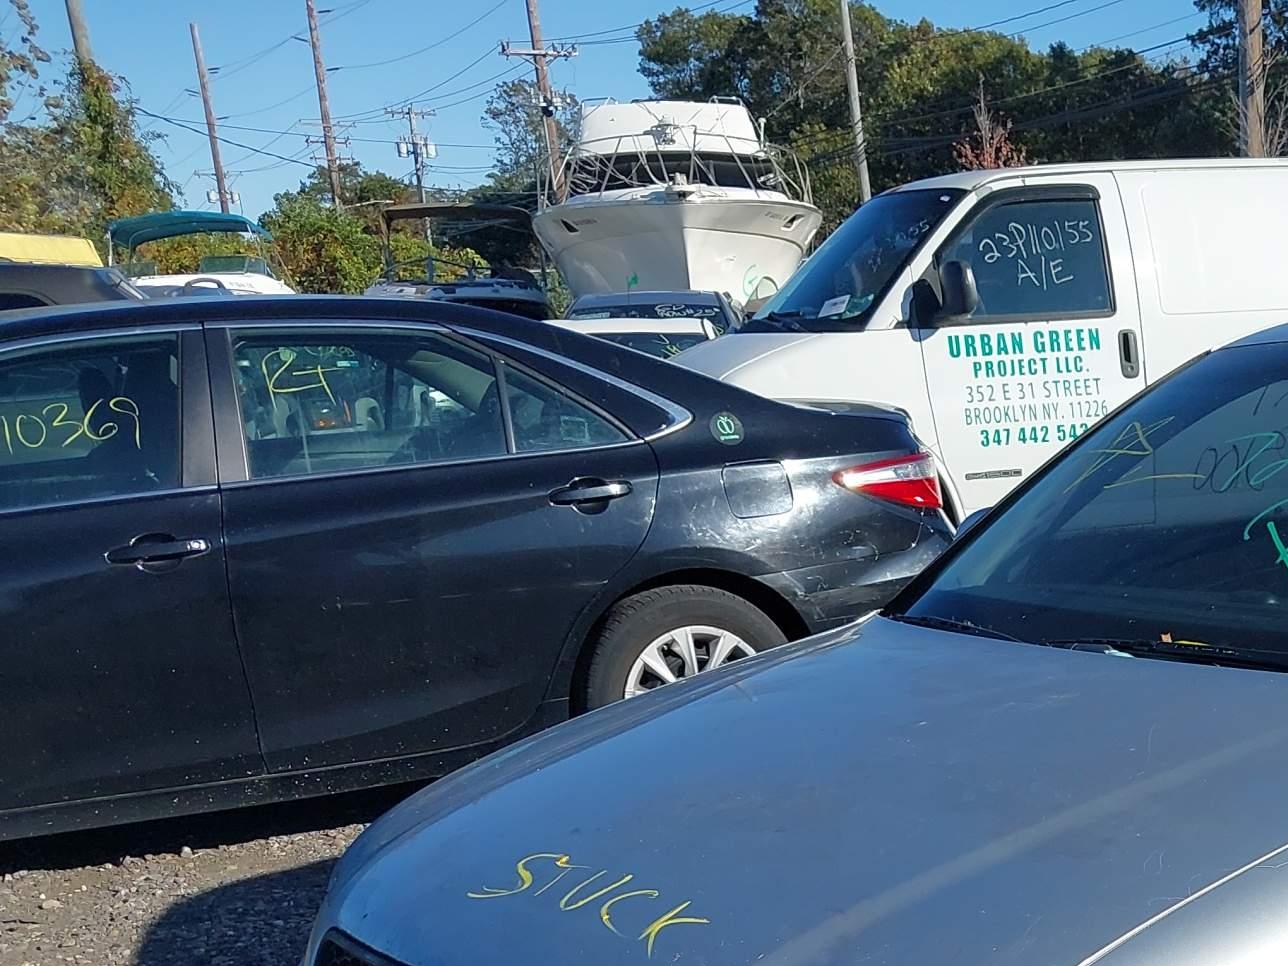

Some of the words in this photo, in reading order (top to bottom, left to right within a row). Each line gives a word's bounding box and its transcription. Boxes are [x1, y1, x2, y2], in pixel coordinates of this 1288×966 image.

[1017, 256, 1073, 290] A/E
[947, 332, 1024, 358] URBAN
[1033, 328, 1101, 353] GREEN
[973, 358, 1048, 378] PROJECT
[1056, 355, 1090, 374] LLC.
[965, 385, 996, 404] 352
[1002, 383, 1011, 400] E
[1017, 382, 1036, 400] 31
[1042, 378, 1102, 399] STREET
[964, 404, 1038, 425] BROOKLYN
[1042, 402, 1065, 420] NY.
[1069, 400, 1108, 418] 11226
[980, 428, 1010, 448] 347
[1018, 425, 1049, 443] 442
[467, 852, 711, 959] STUCK
